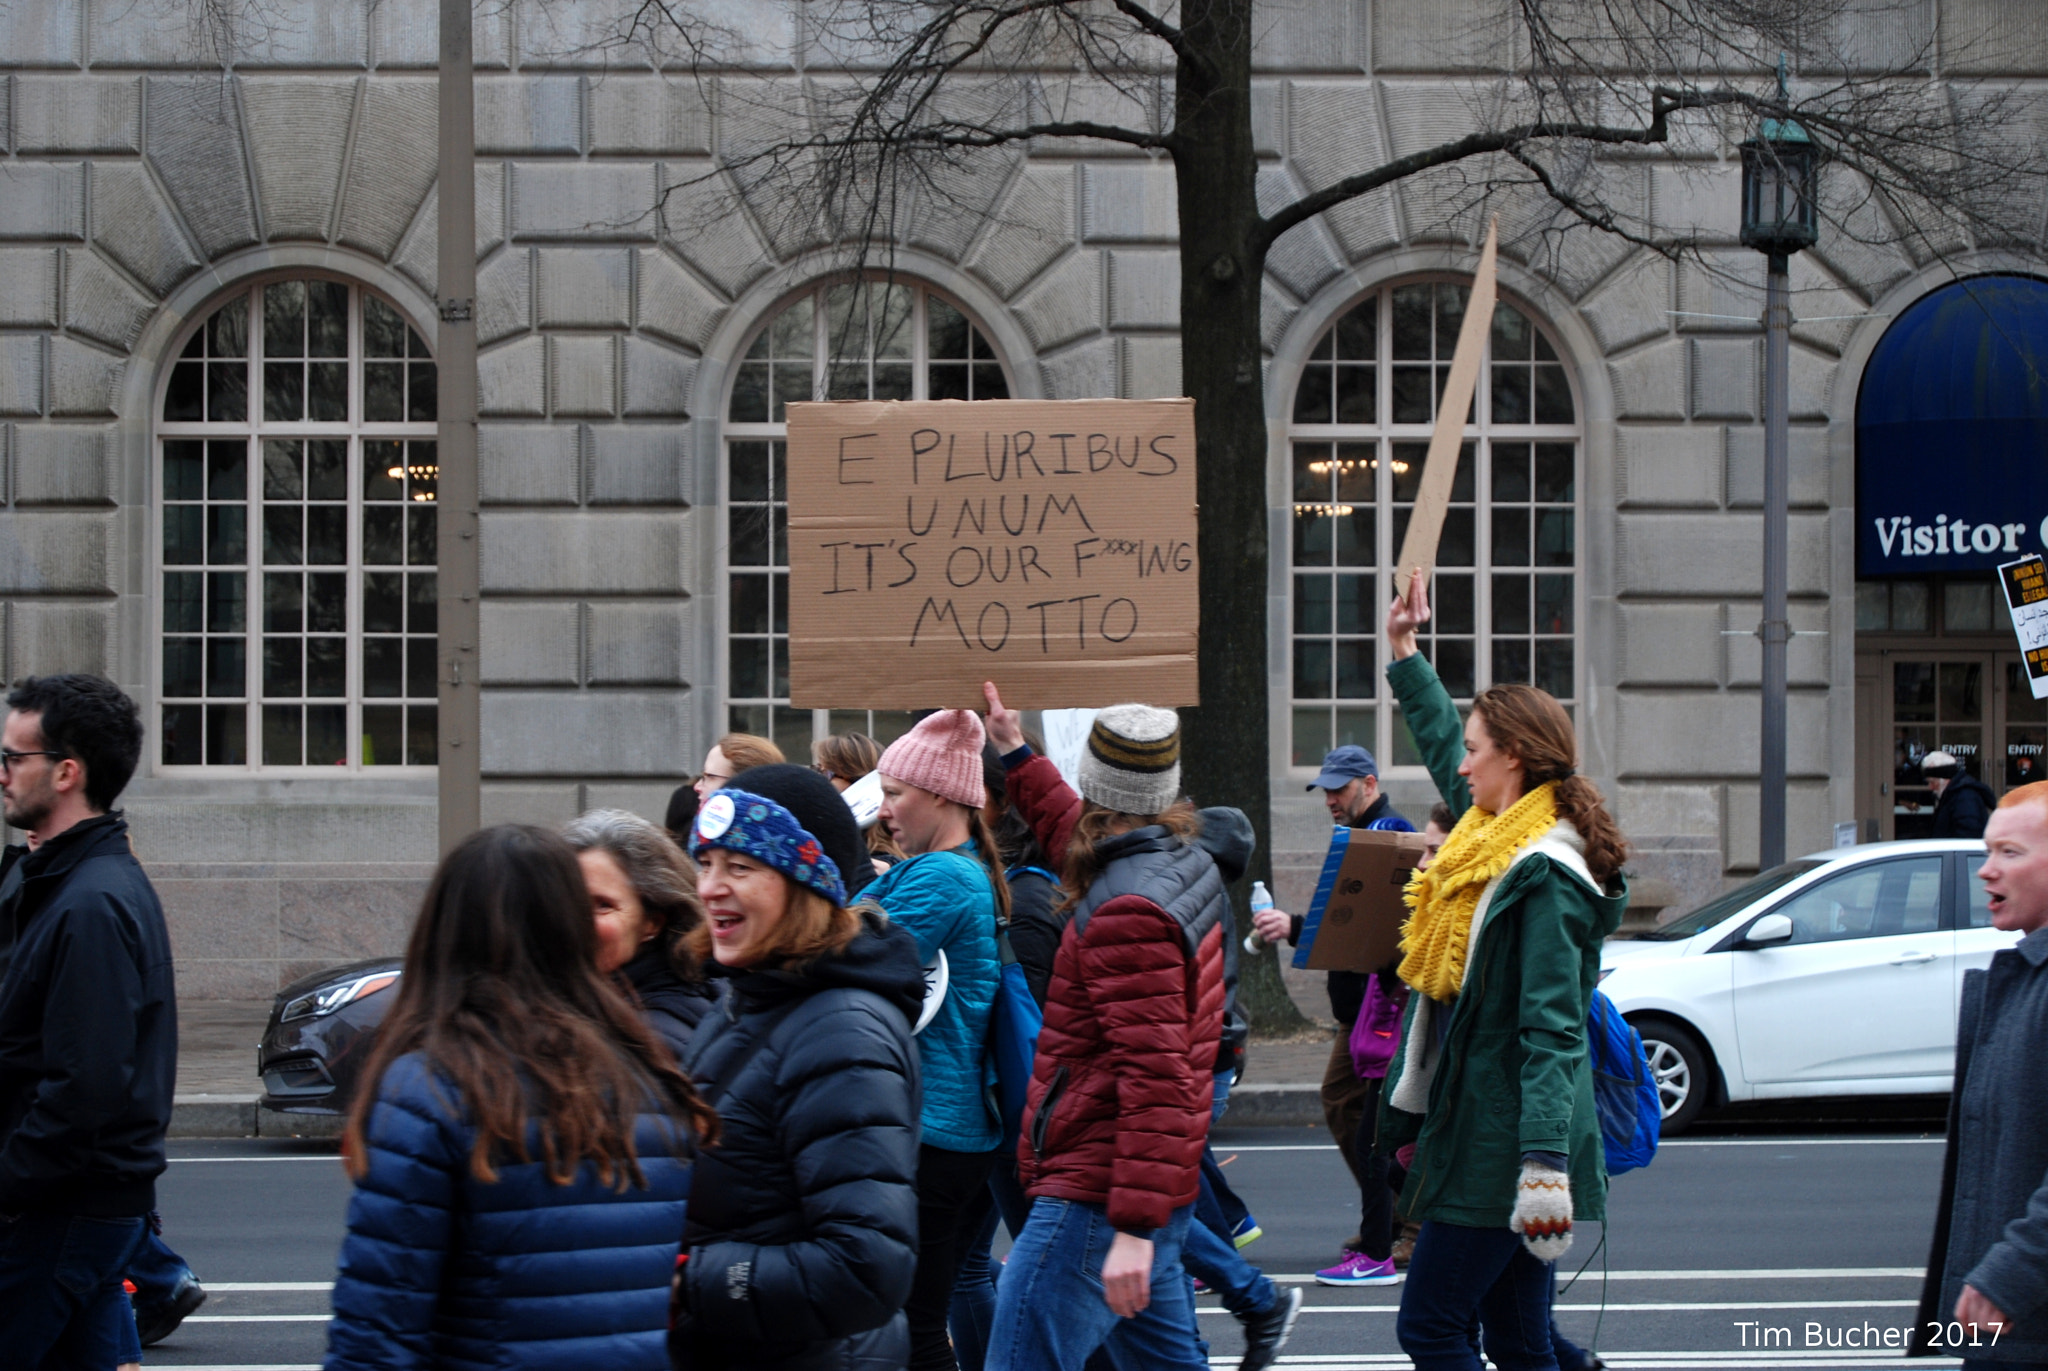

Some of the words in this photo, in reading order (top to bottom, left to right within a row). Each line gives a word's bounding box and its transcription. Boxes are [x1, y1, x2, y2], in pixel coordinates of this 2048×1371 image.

[838, 433, 879, 485] E
[910, 428, 1179, 486] PLURIBUS
[906, 493, 1096, 538] UNUM
[1874, 513, 2027, 559] Visitor
[820, 538, 919, 595] IT'S
[945, 546, 1053, 588] OUR
[910, 593, 1139, 654] MOTTO
[1942, 744, 1977, 755] ENTRY
[2008, 744, 2044, 755] ENTRY
